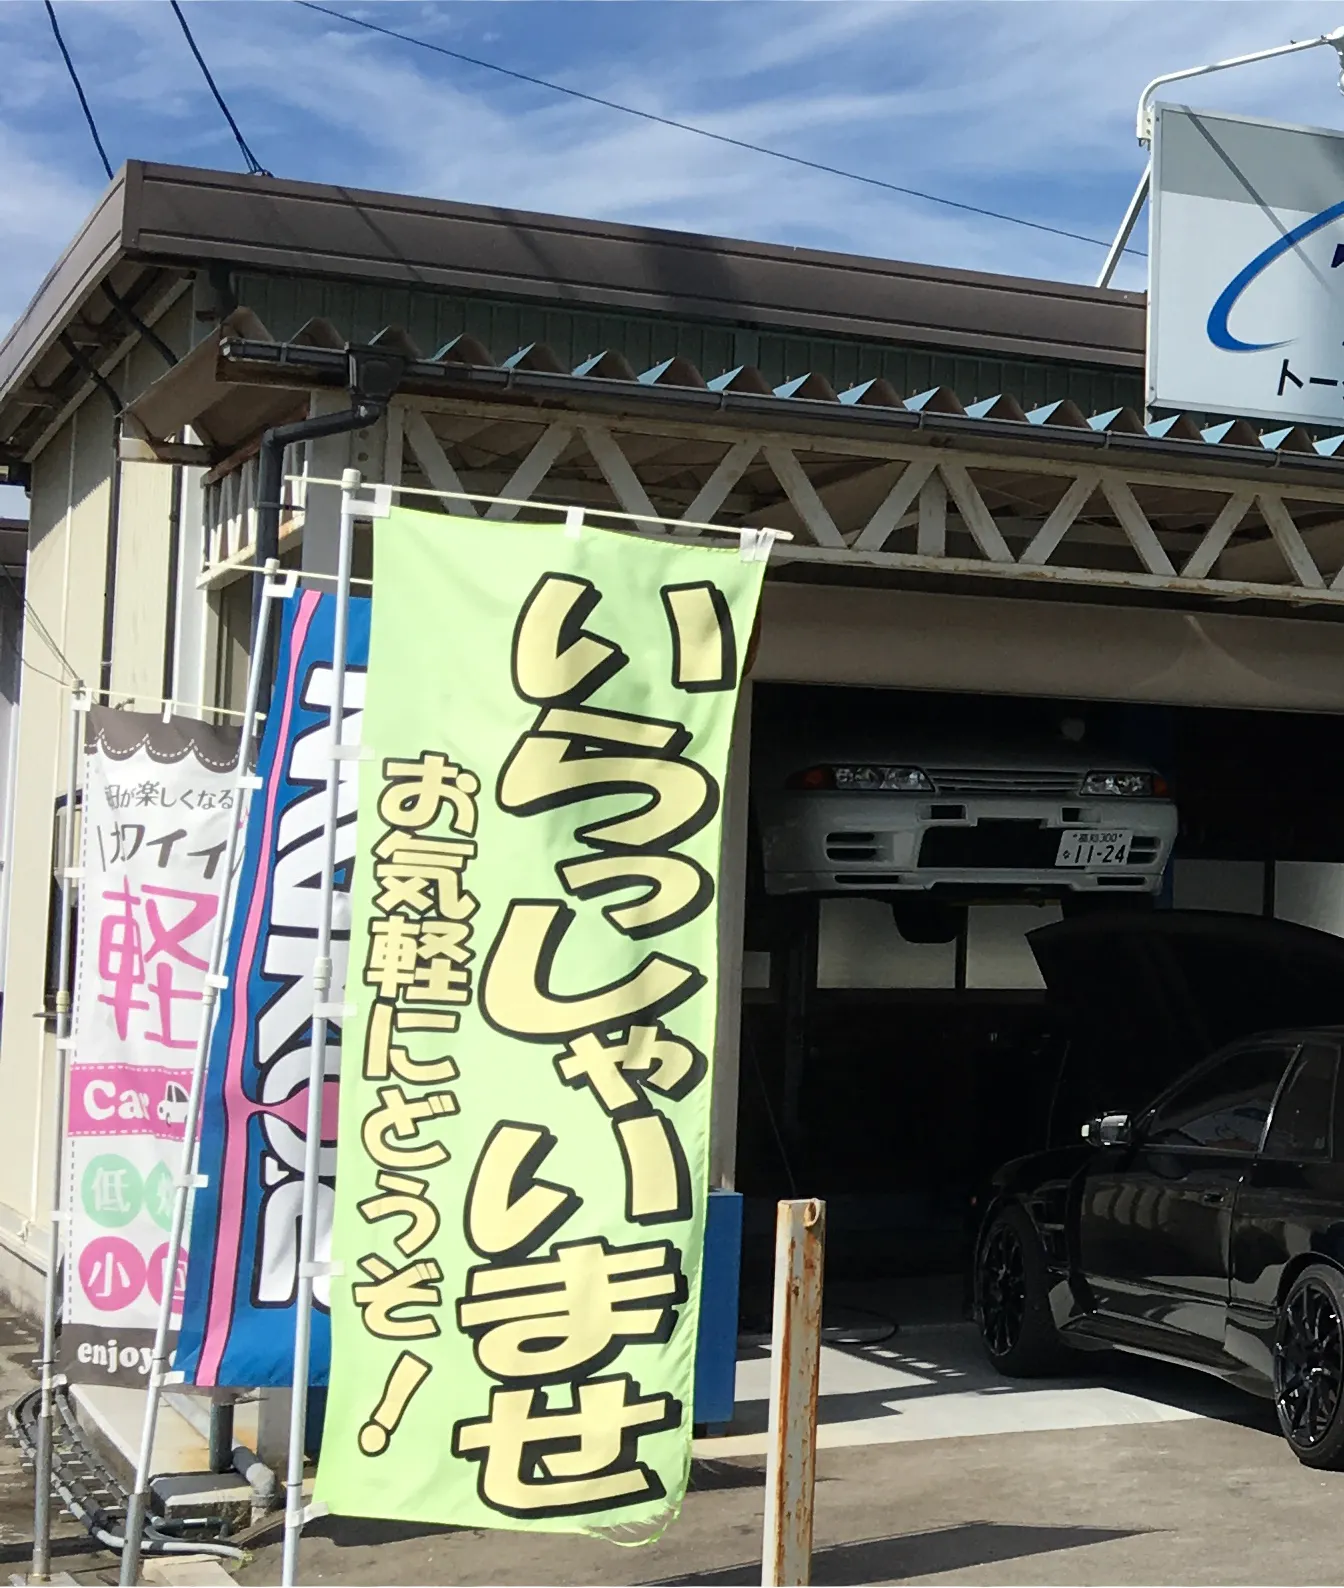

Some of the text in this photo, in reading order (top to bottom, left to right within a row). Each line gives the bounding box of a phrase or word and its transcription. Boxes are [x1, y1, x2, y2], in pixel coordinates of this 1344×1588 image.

[1074, 844, 1126, 863] 11-24
[96, 874, 220, 1050] 軽
[451, 570, 737, 1519] いらっしゃいませ
[77, 1339, 154, 1375] enjoy
